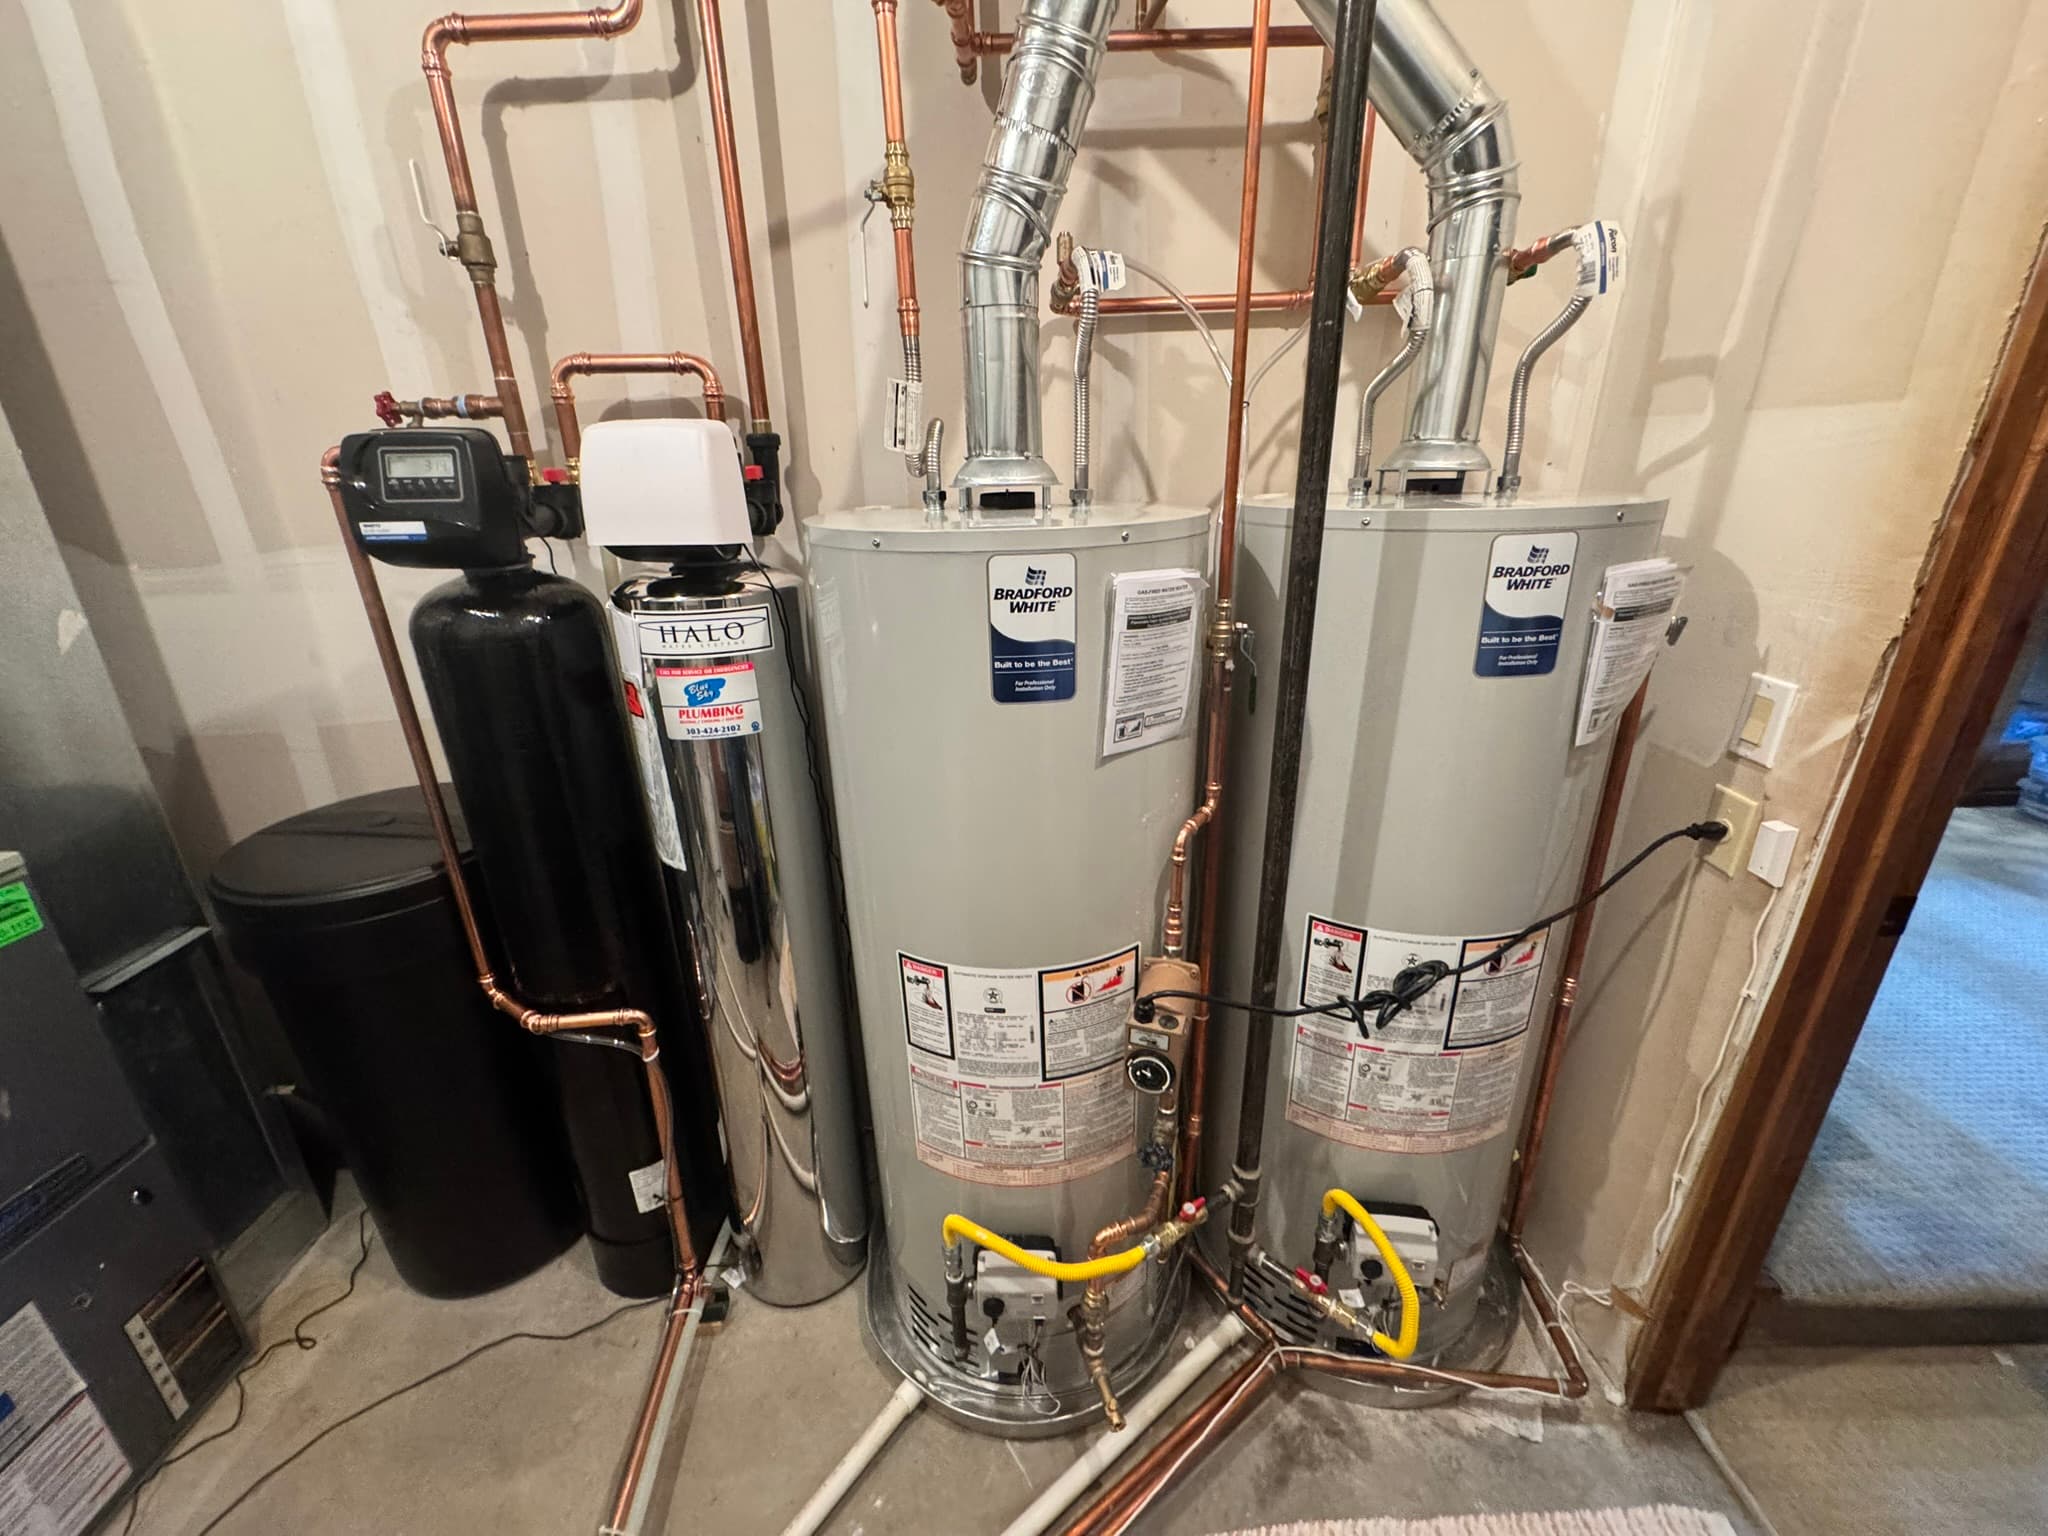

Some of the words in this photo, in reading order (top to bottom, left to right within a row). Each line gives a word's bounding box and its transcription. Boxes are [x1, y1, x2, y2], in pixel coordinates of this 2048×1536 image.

[1493, 564, 1570, 578] BRADFORD
[1506, 578, 1553, 591] WHITE
[993, 586, 1073, 600] BRADFORD
[1009, 600, 1057, 613] WHITE
[659, 621, 744, 643] HALO
[994, 661, 1012, 669] Built
[1014, 661, 1023, 669] to
[1052, 658, 1071, 666] Best
[688, 682, 709, 694] Blue
[696, 689, 714, 701] Sky
[678, 704, 744, 719] PLUMBING
